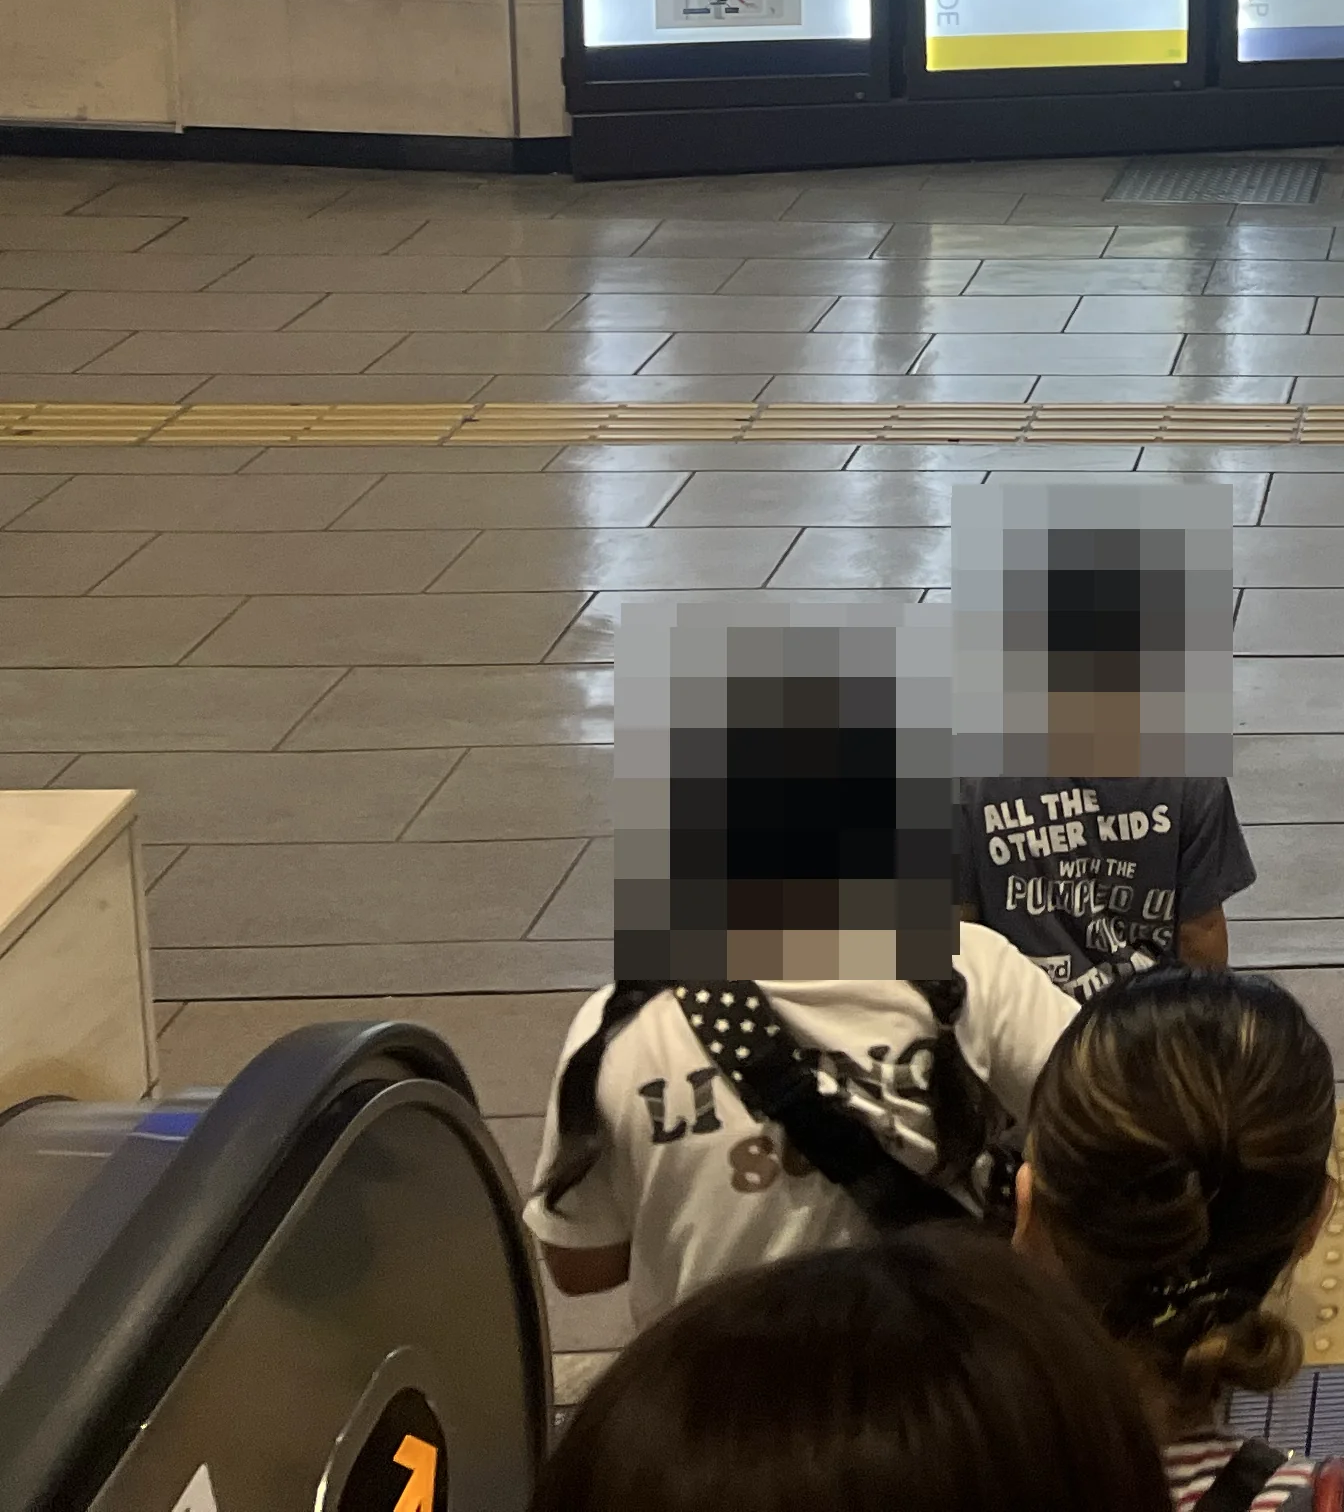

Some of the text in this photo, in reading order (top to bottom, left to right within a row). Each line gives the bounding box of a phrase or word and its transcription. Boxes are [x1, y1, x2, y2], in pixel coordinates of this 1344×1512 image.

[983, 788, 1100, 834] ALL THE
[989, 804, 1172, 865] OTHER KIDS
[1059, 857, 1137, 879] WITH THE
